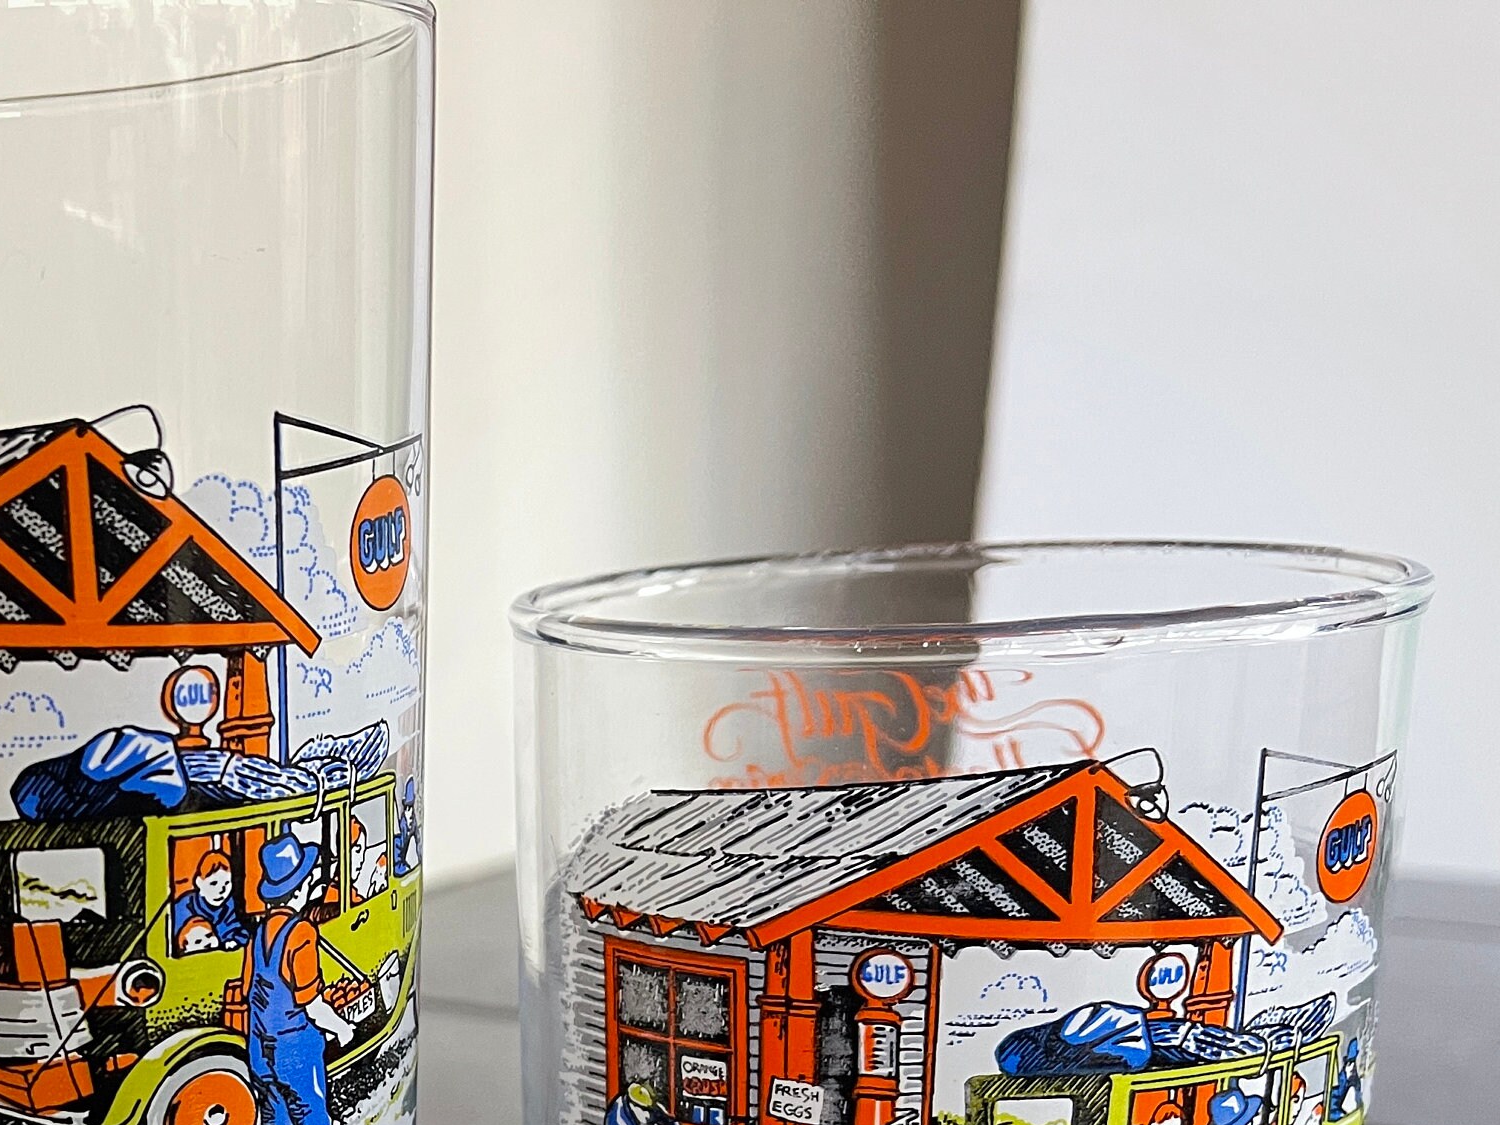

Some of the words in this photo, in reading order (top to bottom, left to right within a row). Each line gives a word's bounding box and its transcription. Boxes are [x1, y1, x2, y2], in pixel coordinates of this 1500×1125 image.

[357, 505, 407, 575] GULF
[1324, 813, 1373, 875] GULF
[861, 960, 907, 985] GULF
[775, 1083, 819, 1104] FRESH
[772, 1101, 812, 1120] EGGS
